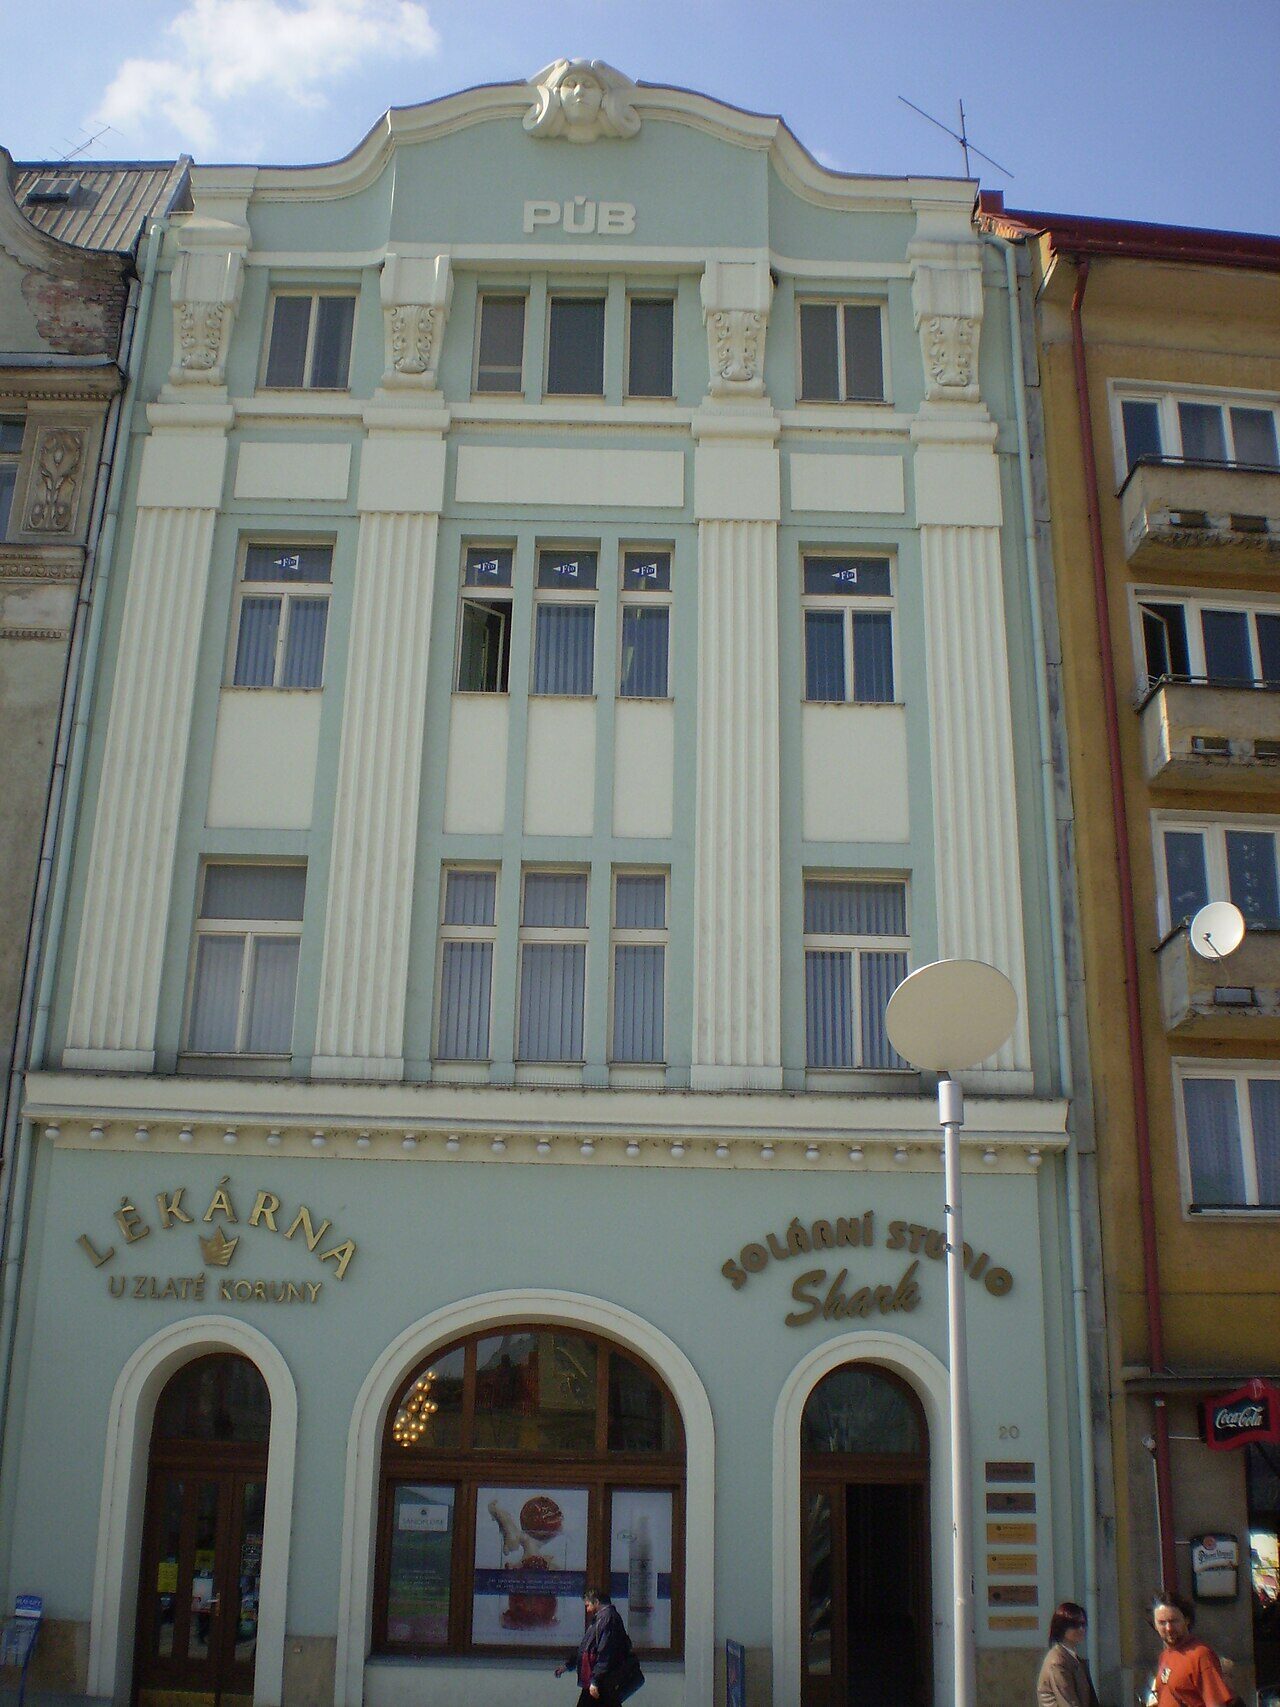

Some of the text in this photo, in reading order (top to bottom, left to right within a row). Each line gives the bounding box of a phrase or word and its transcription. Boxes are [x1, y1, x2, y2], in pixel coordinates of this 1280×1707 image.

[75, 1175, 358, 1281] LÉKÁRNA
[720, 1209, 875, 1291] SOLÁRNÍ
[107, 1272, 323, 1303] U ZLATÉ KORUNY
[785, 1259, 922, 1328] Shark
[998, 1425, 1020, 1440] 20
